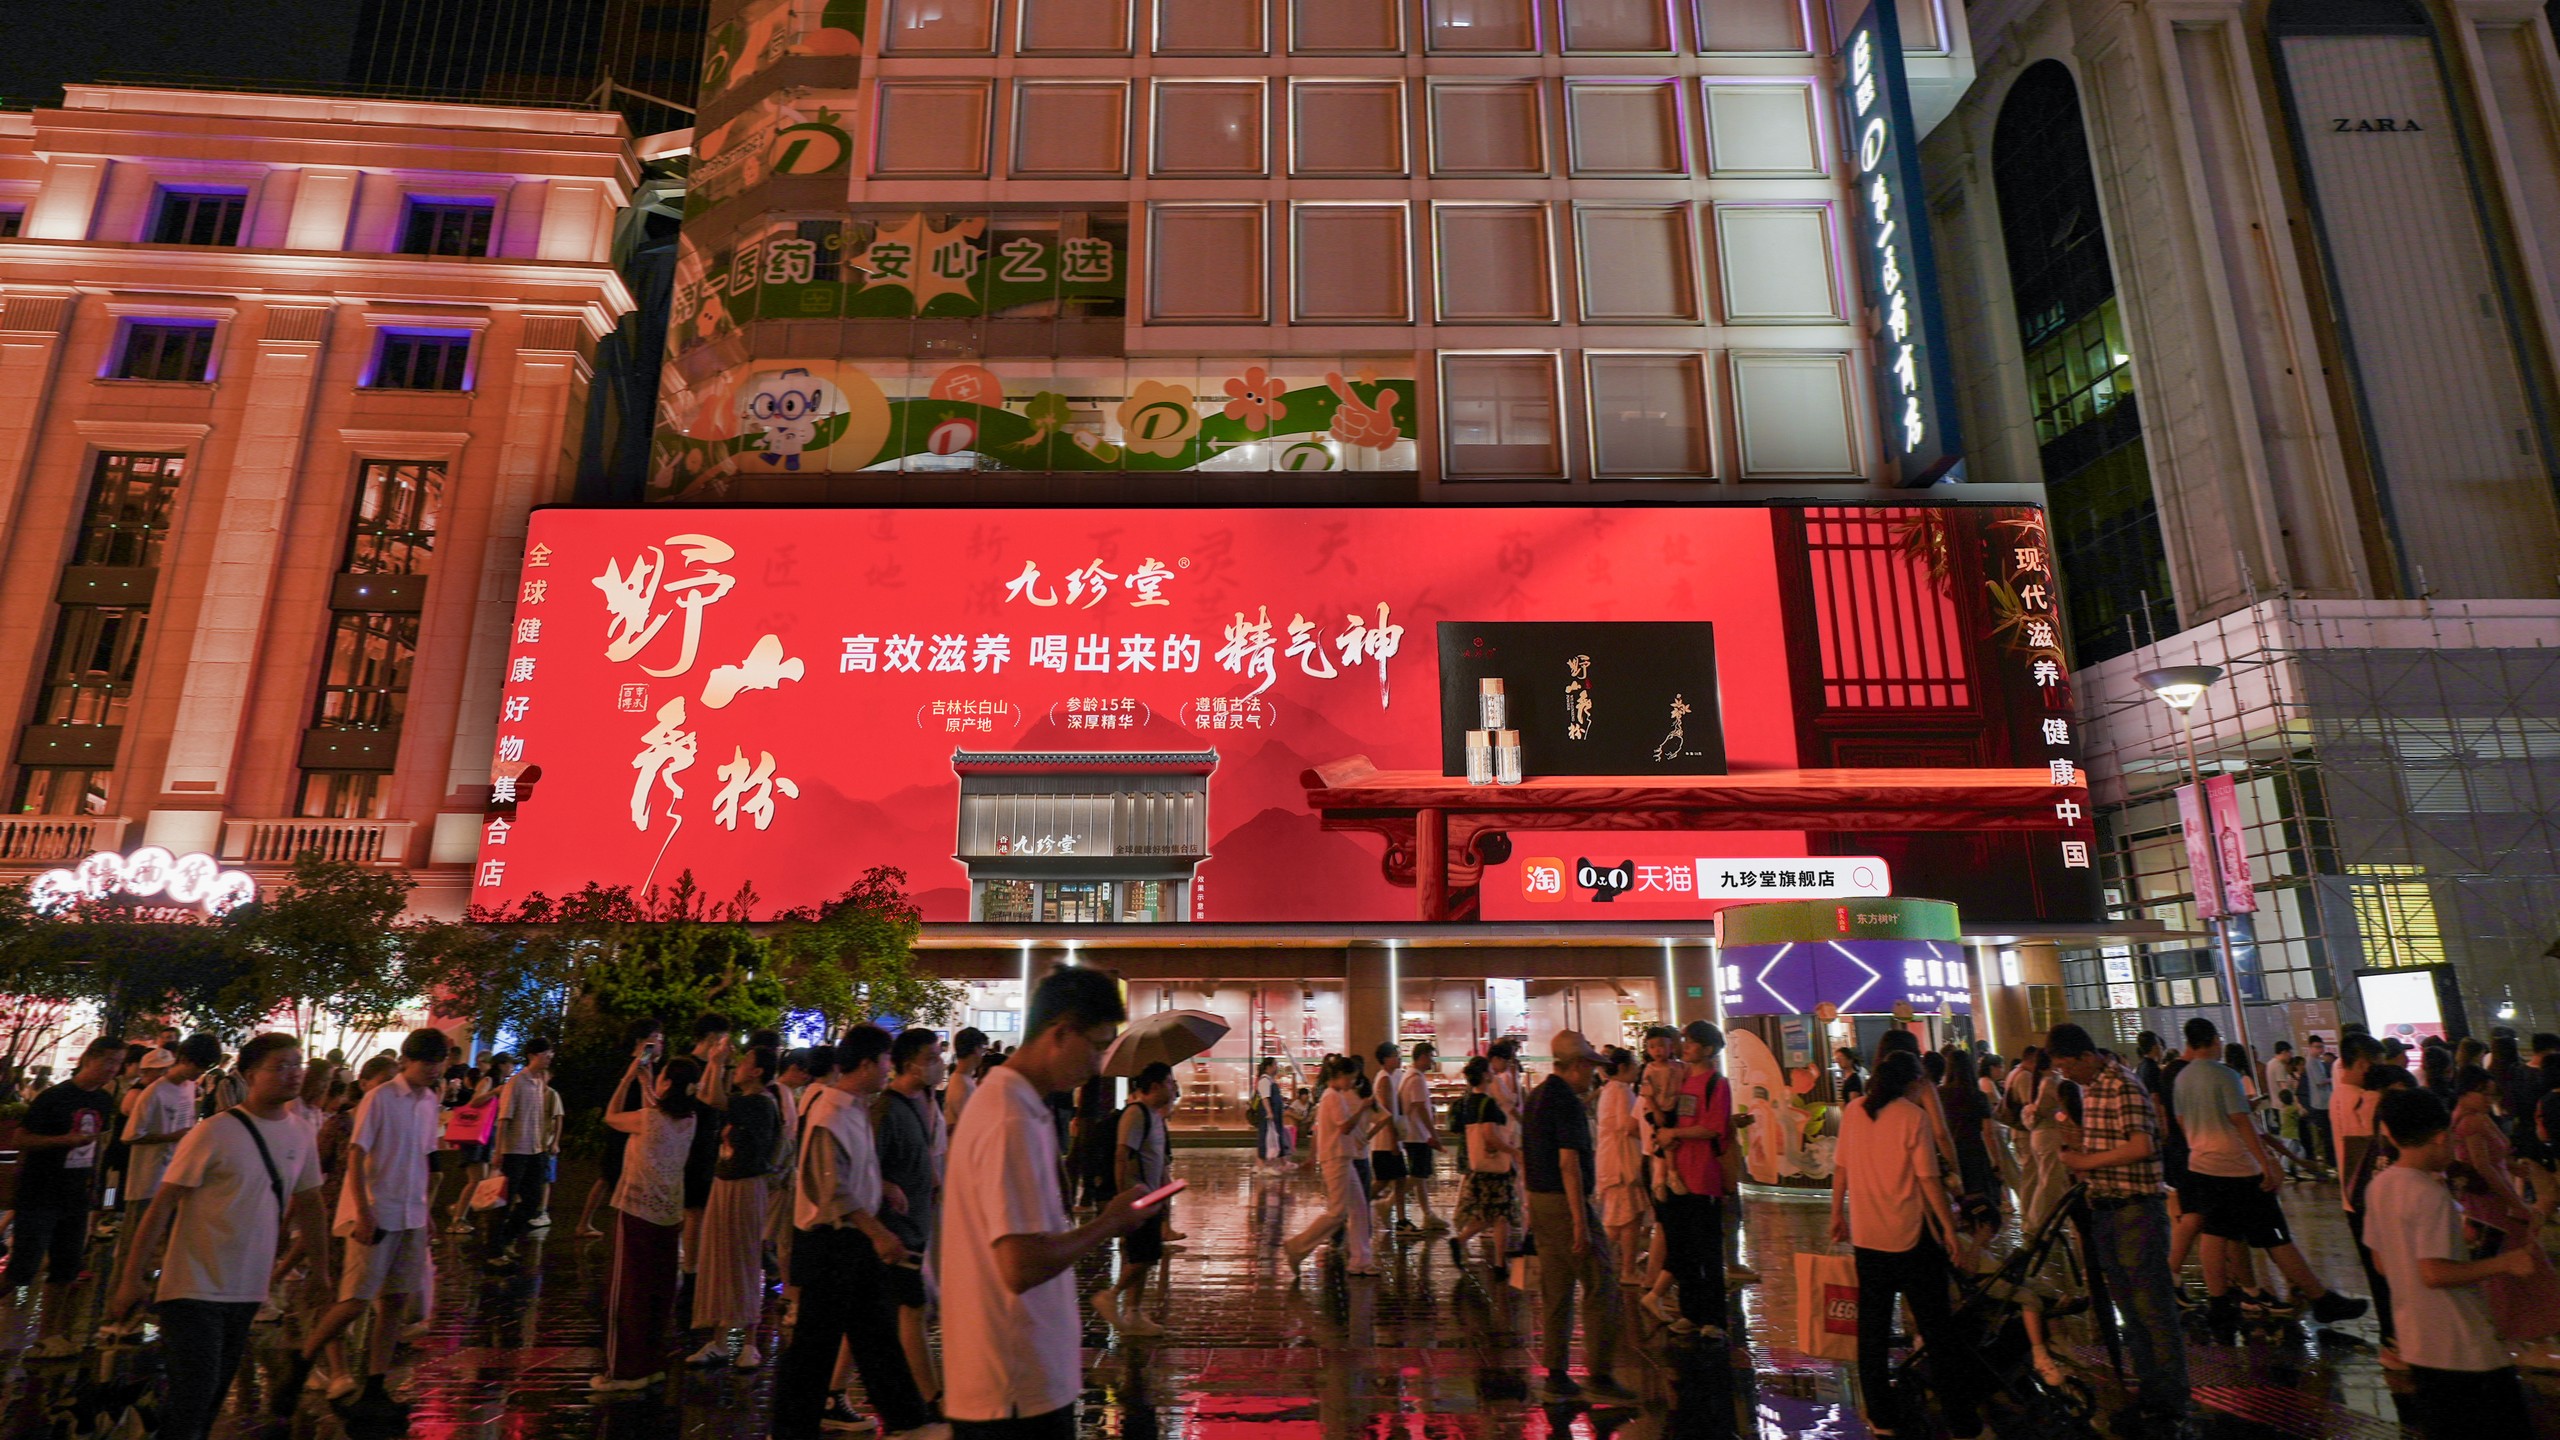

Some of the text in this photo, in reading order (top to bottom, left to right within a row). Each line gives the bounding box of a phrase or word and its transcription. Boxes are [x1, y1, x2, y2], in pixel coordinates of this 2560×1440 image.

[2333, 118, 2424, 132] ZARA
[868, 238, 1114, 284] 安心之选
[838, 601, 1405, 712] 高效滋养 喝出来的 精气神
[932, 699, 1008, 716] 吉林长白山
[1066, 696, 1136, 713] 参龄15年
[1195, 696, 1261, 713] 遵循古法
[2013, 547, 2090, 869] 现代滋养 健康中国
[478, 541, 553, 888] 全球健康好物集合店
[1067, 713, 1134, 730] 深厚精华
[1195, 713, 1262, 731] 保留灵气
[945, 717, 992, 733] 原产地
[998, 835, 1009, 854] 香港
[1013, 834, 1077, 855] 九珍堂
[1115, 843, 1199, 855] 全球健康好物集合店
[1526, 866, 1560, 894] 淘
[1637, 865, 1692, 893] 天猫
[1720, 869, 1836, 889] 九珍堂旗舰店
[1196, 874, 1205, 920] 效果示意图
[1856, 912, 1899, 925] 东方树叶
[1829, 1299, 1858, 1320] LEG
